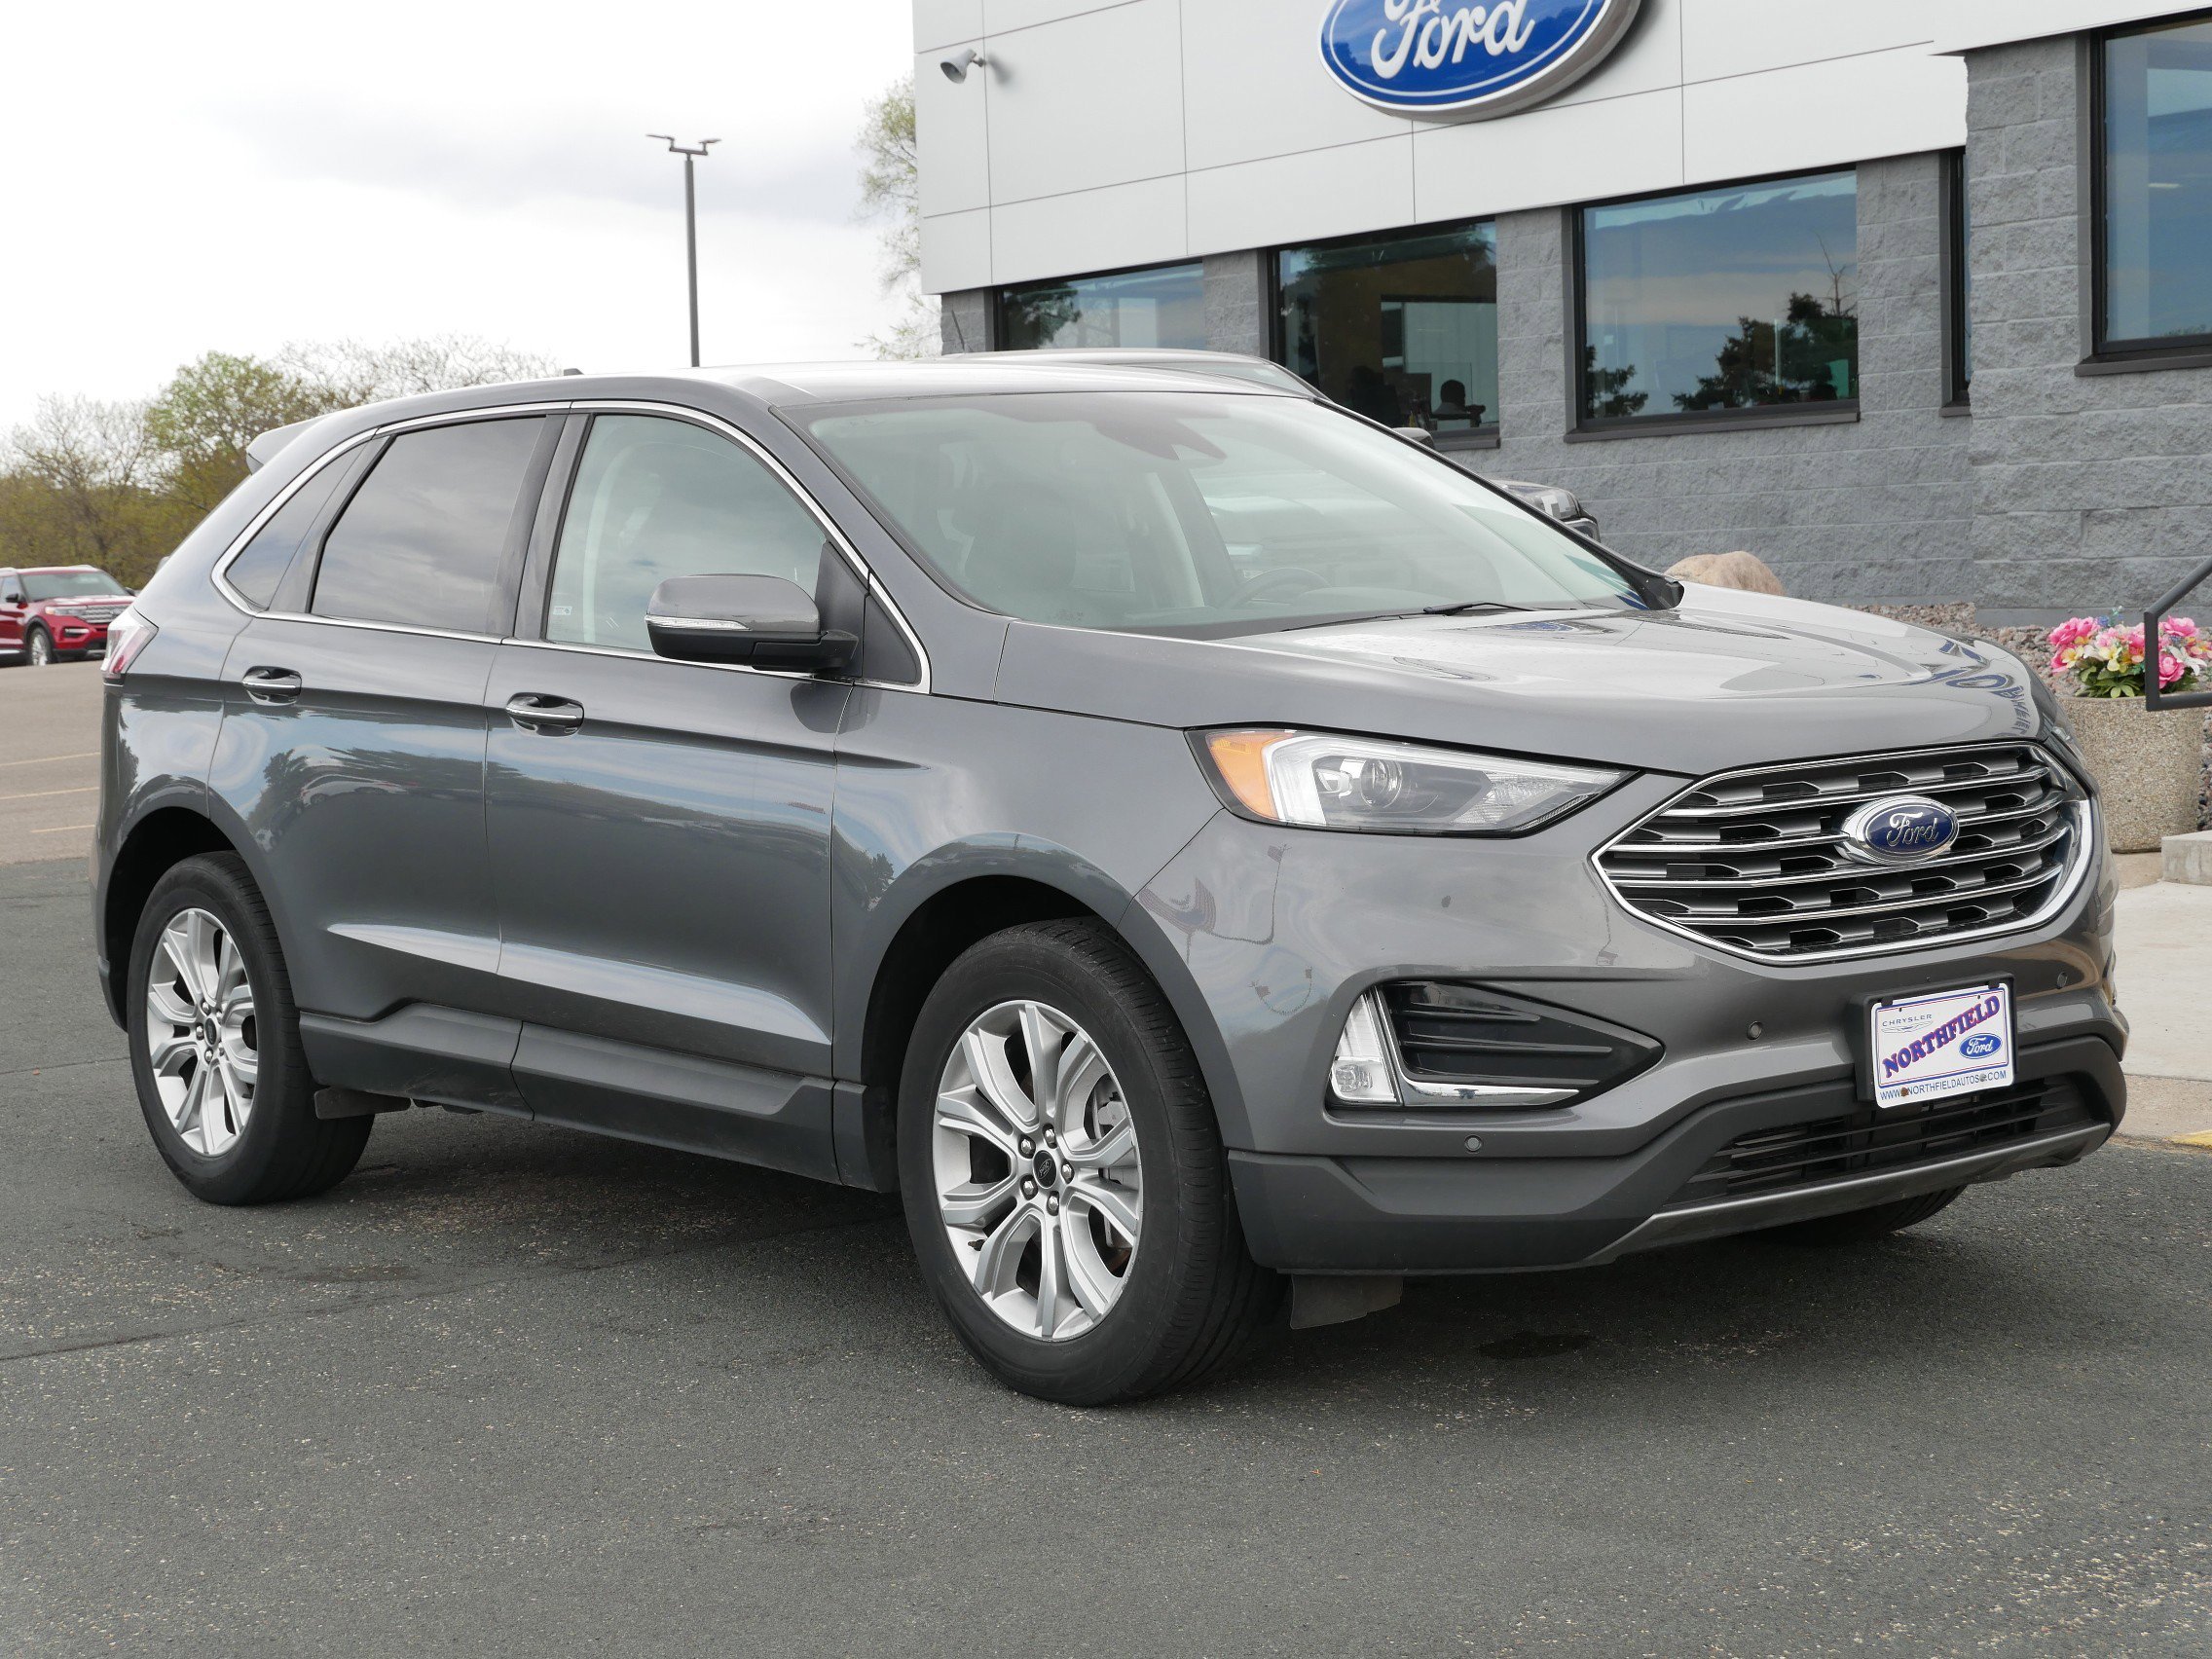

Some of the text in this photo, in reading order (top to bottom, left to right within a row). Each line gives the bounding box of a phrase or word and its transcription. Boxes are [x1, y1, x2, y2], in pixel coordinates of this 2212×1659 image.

[1371, 0, 1535, 79] Ford
[1886, 812, 1939, 847] Ford
[1882, 1014, 1932, 1027] CHRYSLER
[1882, 995, 2001, 1078] NORTHFIELD
[1967, 1036, 1994, 1054] Ford
[1880, 1070, 2007, 1100] WWWNORTHFIELDAUTOS.COM
